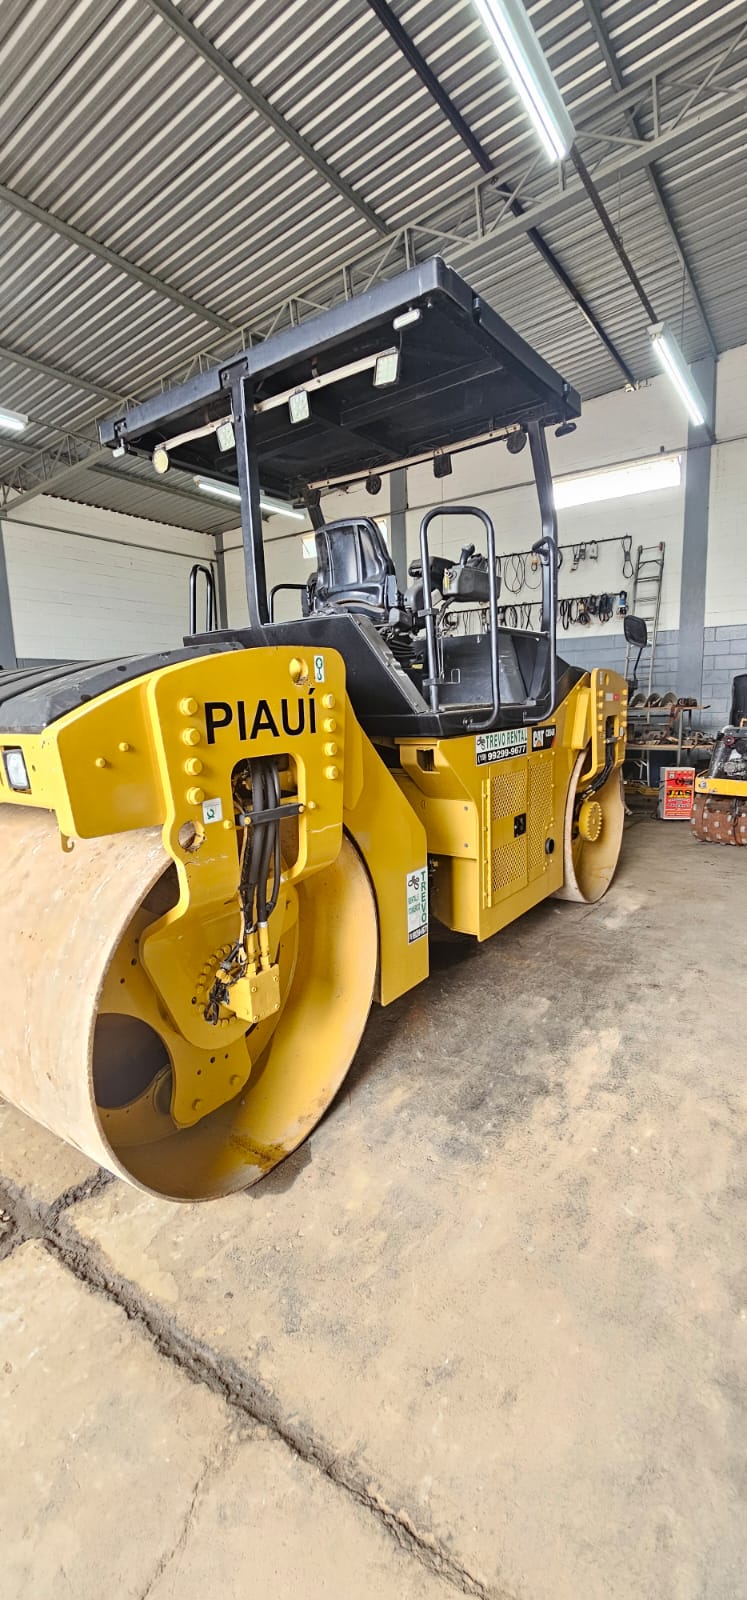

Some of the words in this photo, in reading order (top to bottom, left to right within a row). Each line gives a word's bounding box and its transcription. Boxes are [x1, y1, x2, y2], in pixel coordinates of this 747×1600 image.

[204, 688, 316, 744] PIAUÍ
[485, 733, 506, 749] TREVO
[507, 729, 528, 745] RENTAL
[532, 729, 545, 748] CAT
